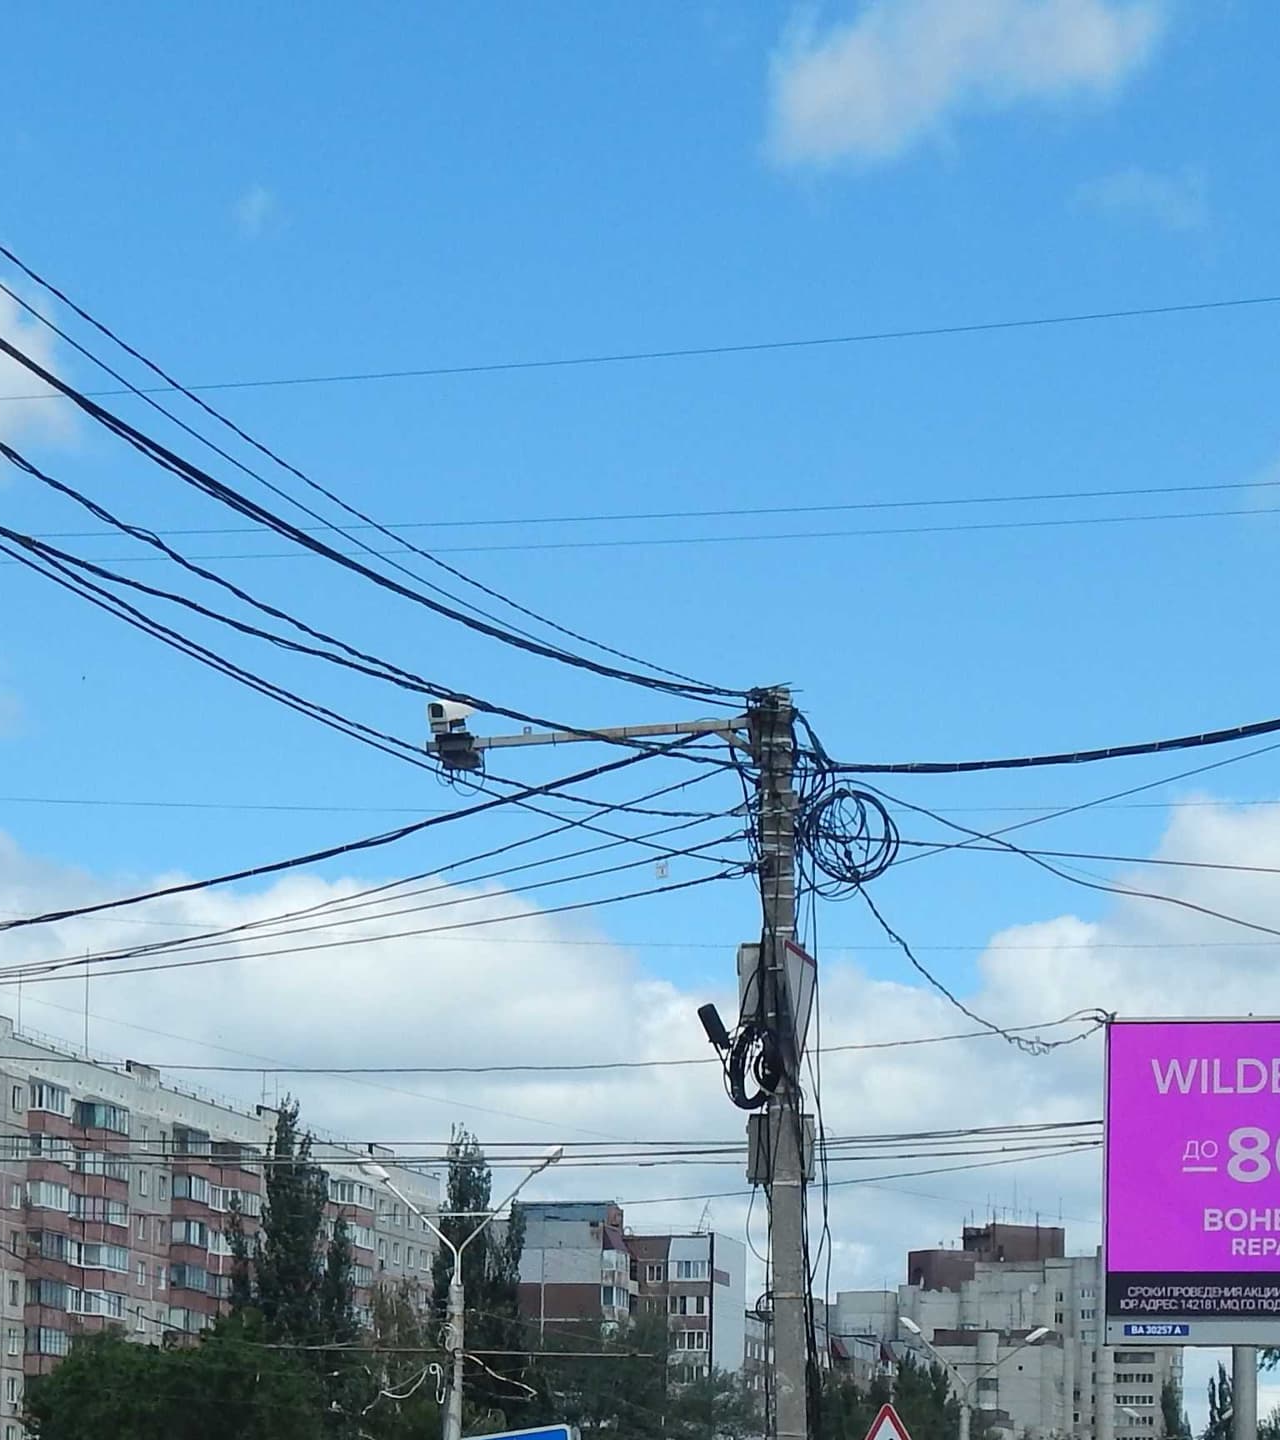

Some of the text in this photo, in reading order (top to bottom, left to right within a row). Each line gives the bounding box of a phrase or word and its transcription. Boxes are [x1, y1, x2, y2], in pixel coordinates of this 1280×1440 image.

[1182, 1140, 1219, 1161] ДО
[1127, 1286, 1166, 1297] СРОКИ
[1167, 1286, 1242, 1298] ПРОВЕДЕНИЯ
